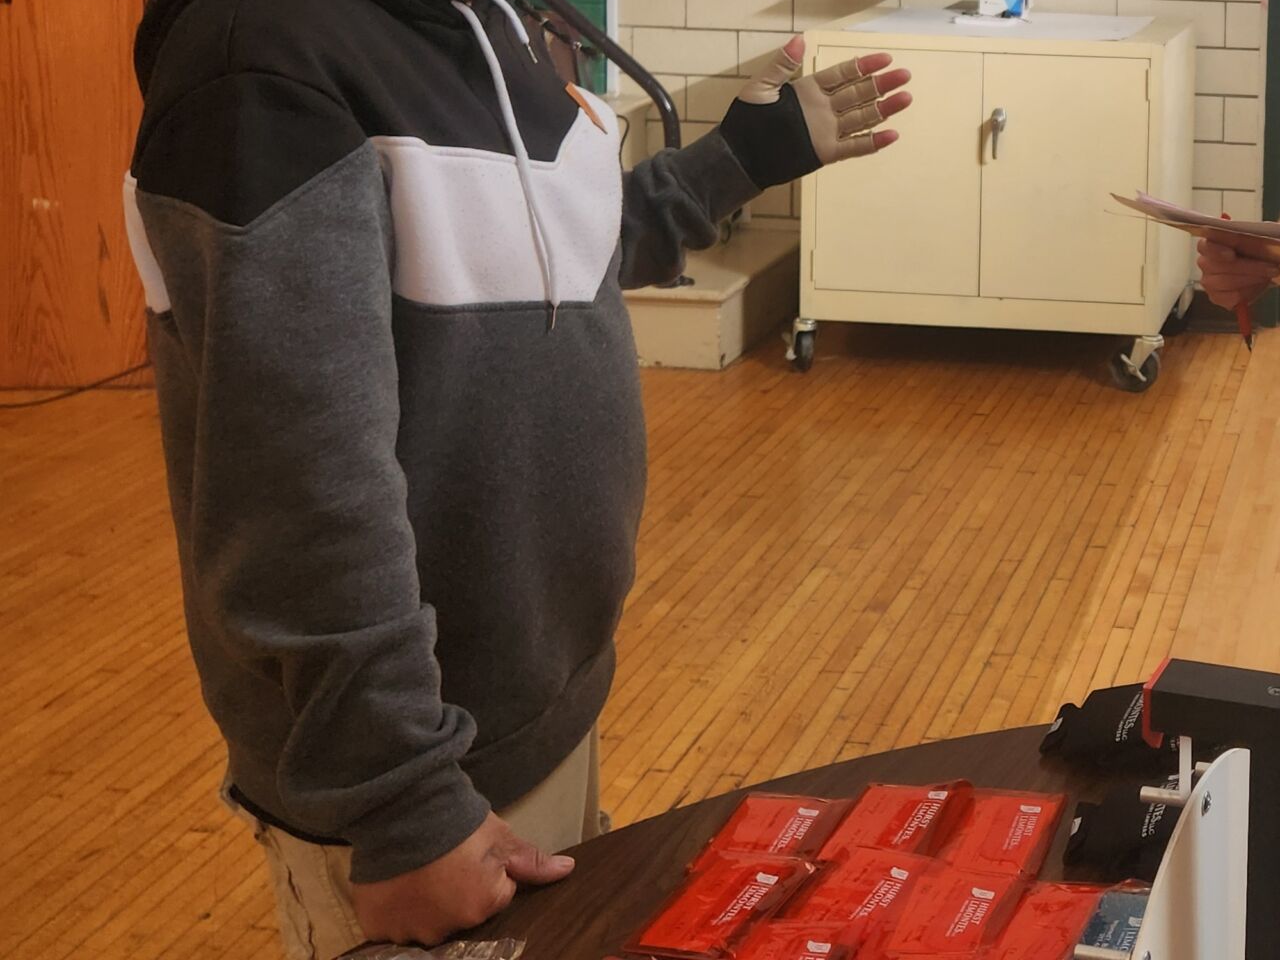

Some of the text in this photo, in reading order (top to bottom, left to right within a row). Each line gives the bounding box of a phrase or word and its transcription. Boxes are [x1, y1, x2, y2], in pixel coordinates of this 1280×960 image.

[918, 803, 941, 828] HURST
[1023, 815, 1039, 836] HURST
[743, 887, 769, 910] HURST
[879, 883, 902, 907] HURST
[954, 900, 981, 933] LIMONTES
[970, 902, 991, 925] HURST
